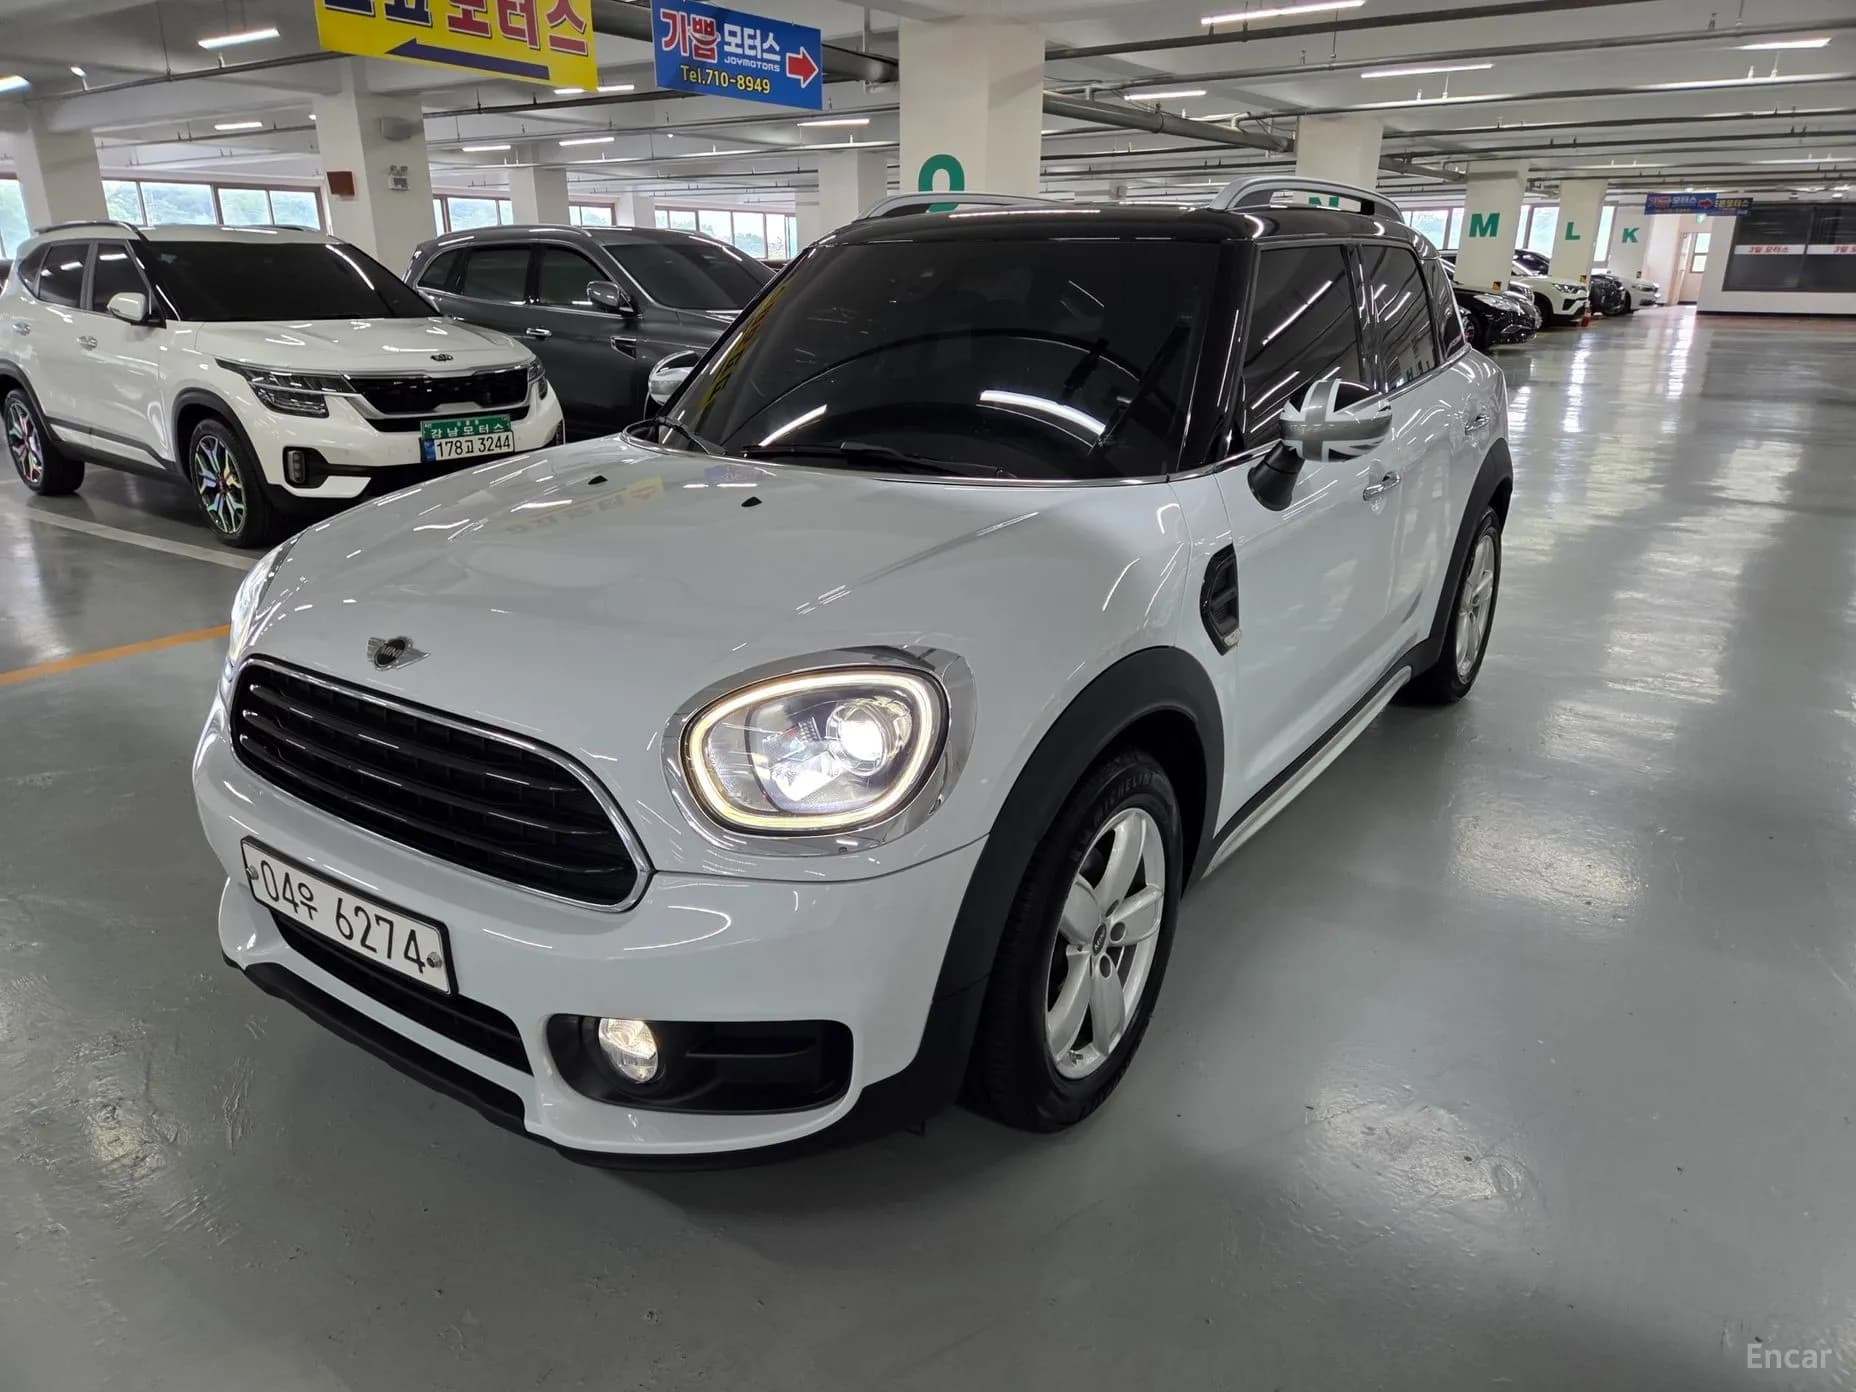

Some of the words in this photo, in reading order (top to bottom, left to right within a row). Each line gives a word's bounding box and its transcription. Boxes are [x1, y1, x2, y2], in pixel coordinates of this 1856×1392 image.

[447, 0, 589, 56] 모터스
[660, 8, 721, 63] 기쁨
[723, 23, 781, 61] 모터스
[724, 56, 780, 72] JOYMOTORS
[680, 65, 771, 94] Tel.710-8949
[1469, 213, 1500, 238] M
[1565, 222, 1581, 241] L
[1622, 227, 1640, 243] K
[436, 439, 474, 457] 178고
[478, 434, 511, 453] 3244
[260, 859, 318, 921] 04우
[335, 897, 426, 974] 6274
